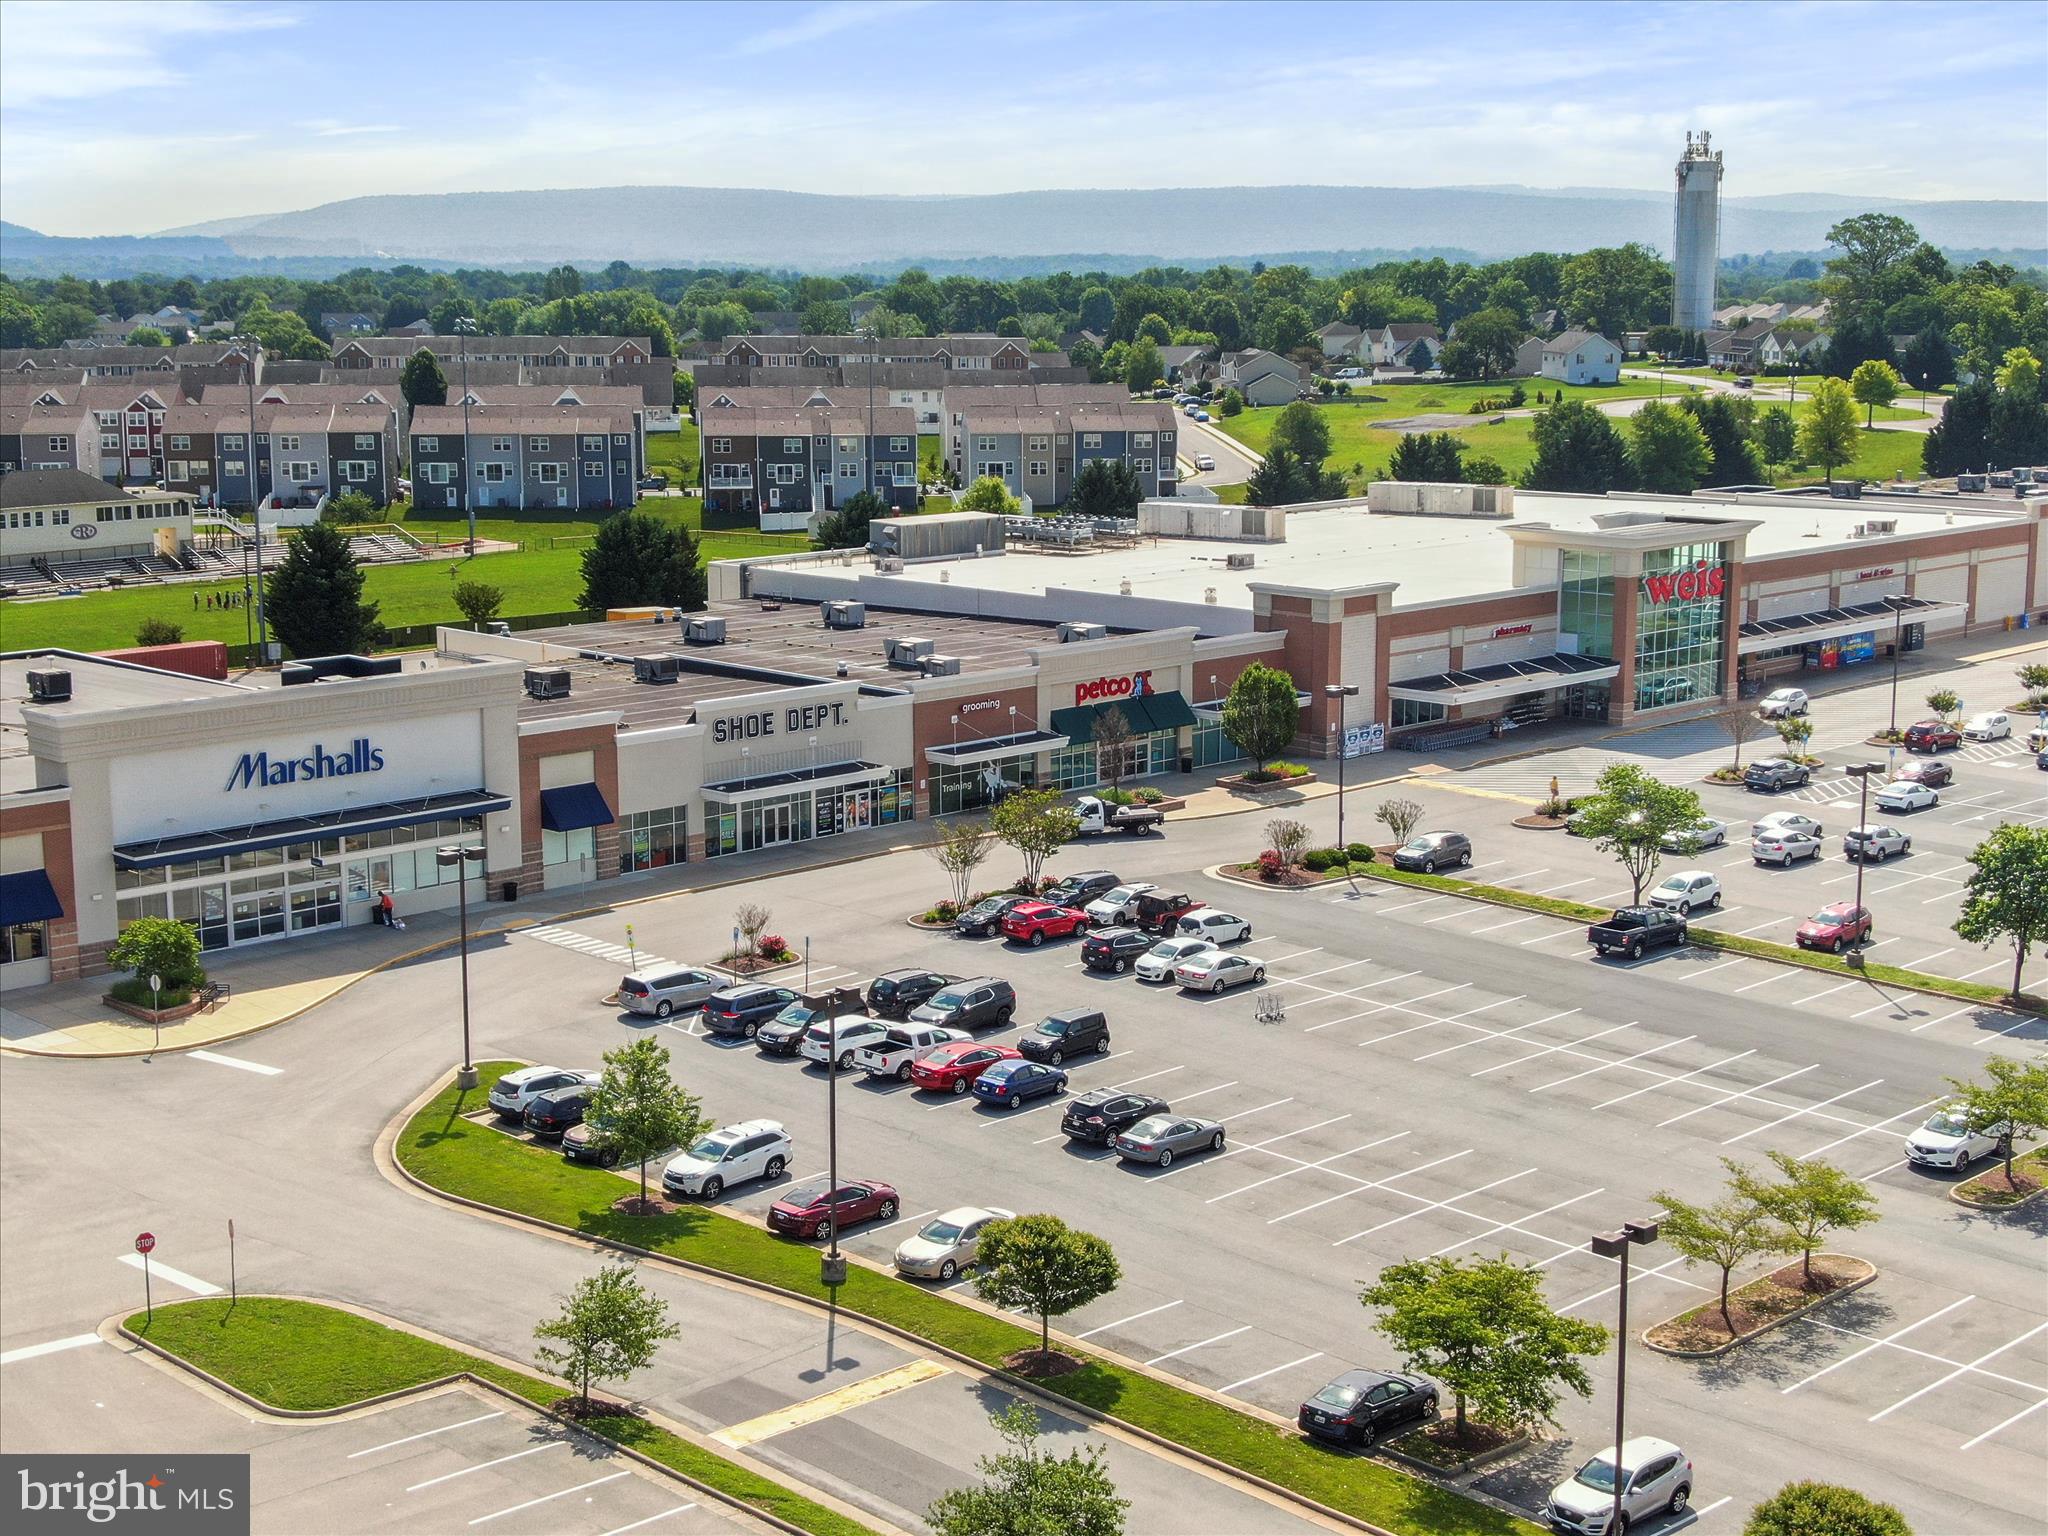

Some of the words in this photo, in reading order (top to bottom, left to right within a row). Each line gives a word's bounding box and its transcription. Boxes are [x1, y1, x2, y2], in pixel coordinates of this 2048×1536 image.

[1643, 560, 1725, 605] weis
[962, 699, 1000, 714] grooming
[1075, 676, 1131, 707] petco
[713, 711, 775, 744] SHOE
[786, 701, 849, 733] DEPT.
[225, 737, 384, 792] Marshalls
[942, 781, 972, 793] Training
[136, 1238, 153, 1248] STOP
